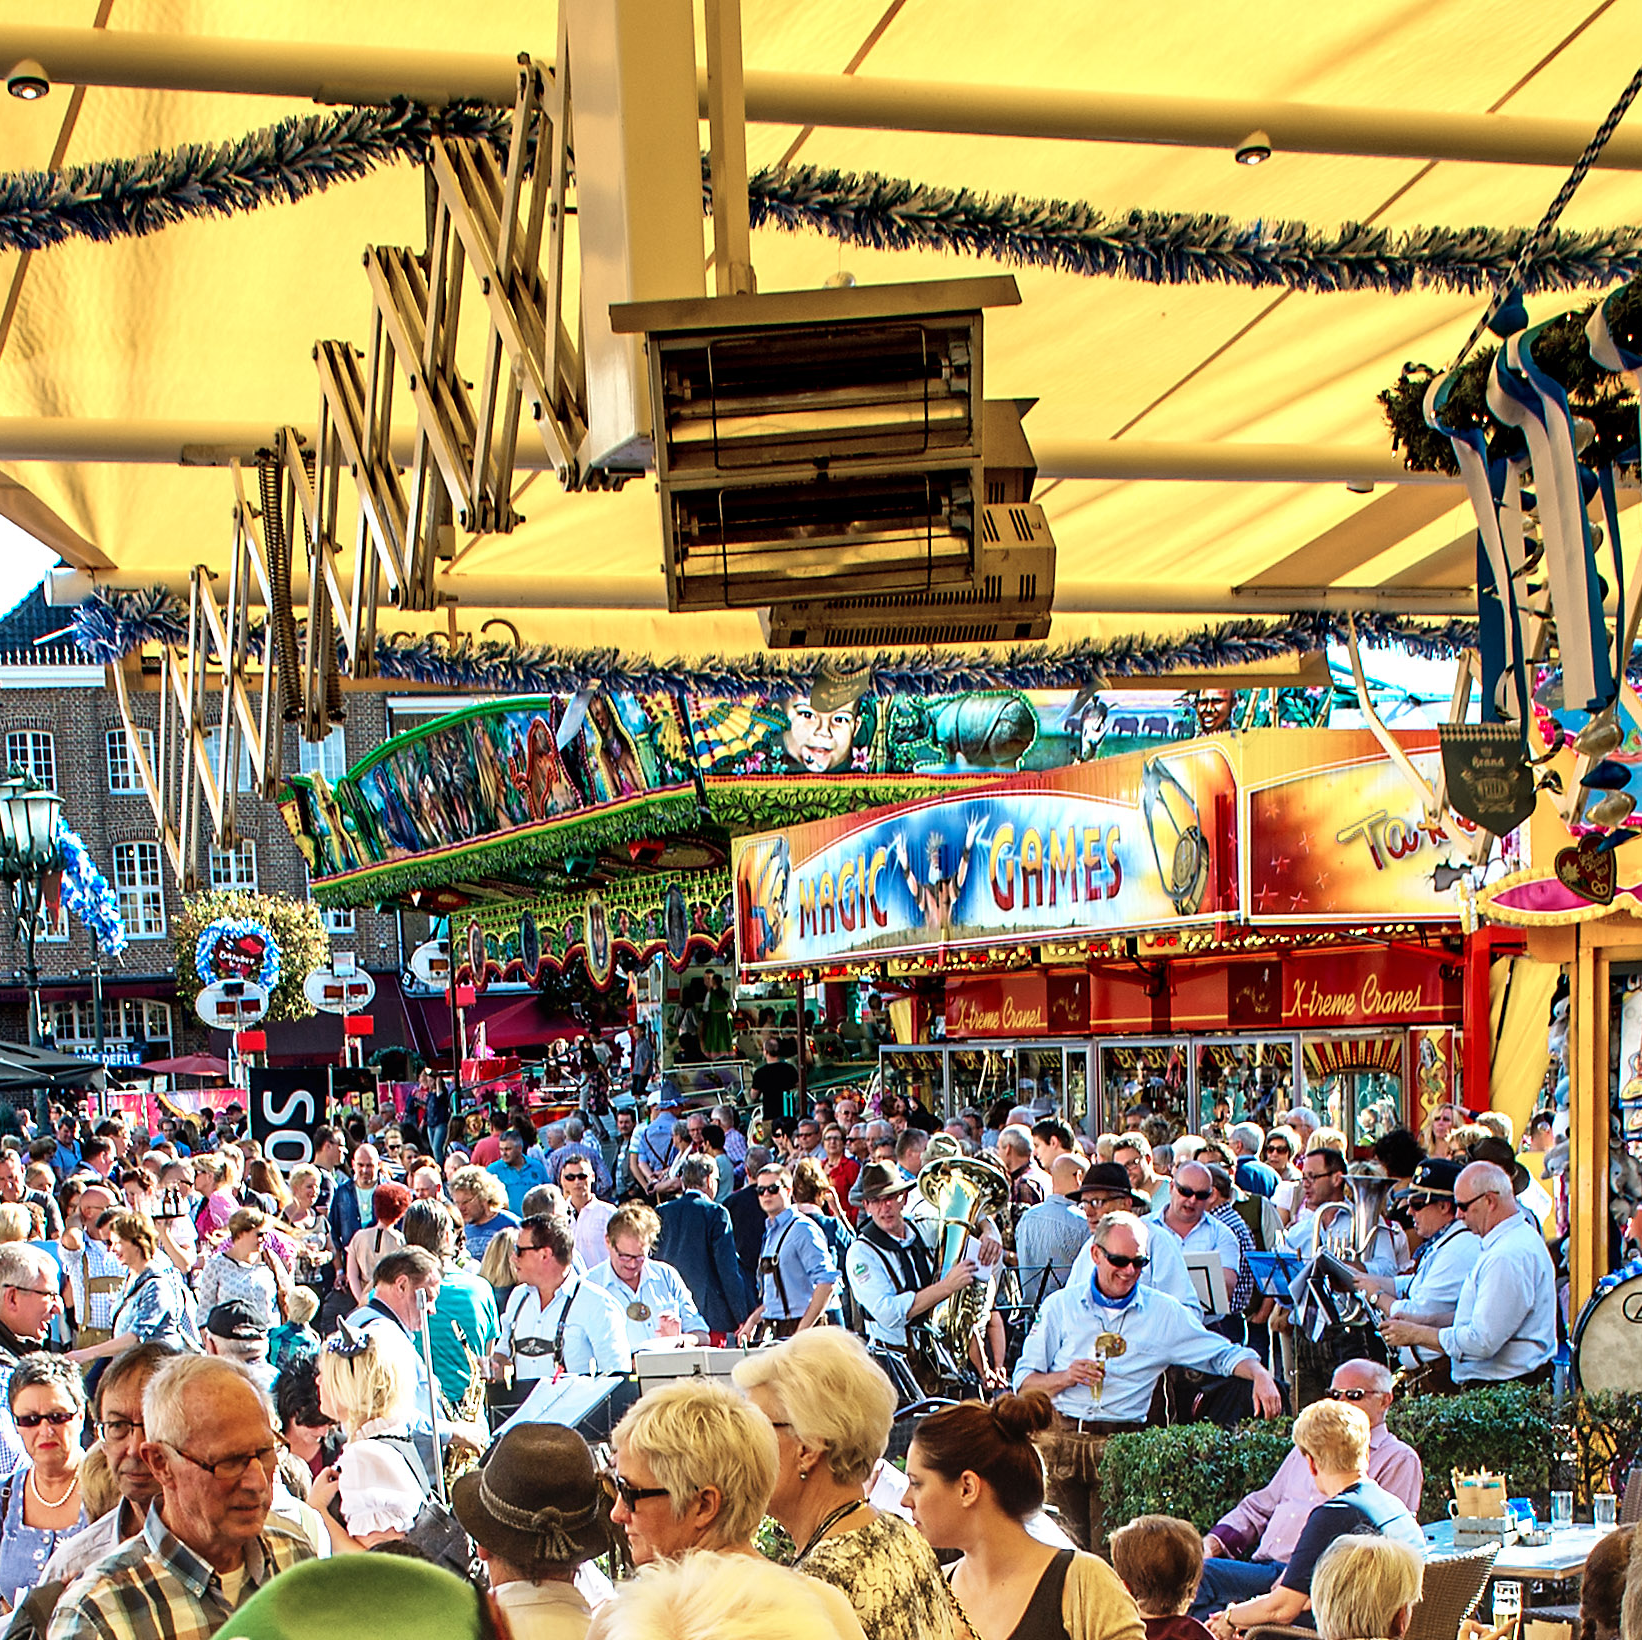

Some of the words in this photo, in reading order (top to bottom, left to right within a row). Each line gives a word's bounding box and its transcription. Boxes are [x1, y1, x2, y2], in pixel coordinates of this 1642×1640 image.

[799, 846, 888, 939] MAGIC
[989, 824, 1123, 912] GAMES
[957, 999, 1001, 1030] X-treme
[1002, 996, 1042, 1029] Cranes
[1290, 978, 1356, 1018] X-treme
[1361, 973, 1422, 1014] Cranes
[102, 1053, 141, 1066] DEFILE
